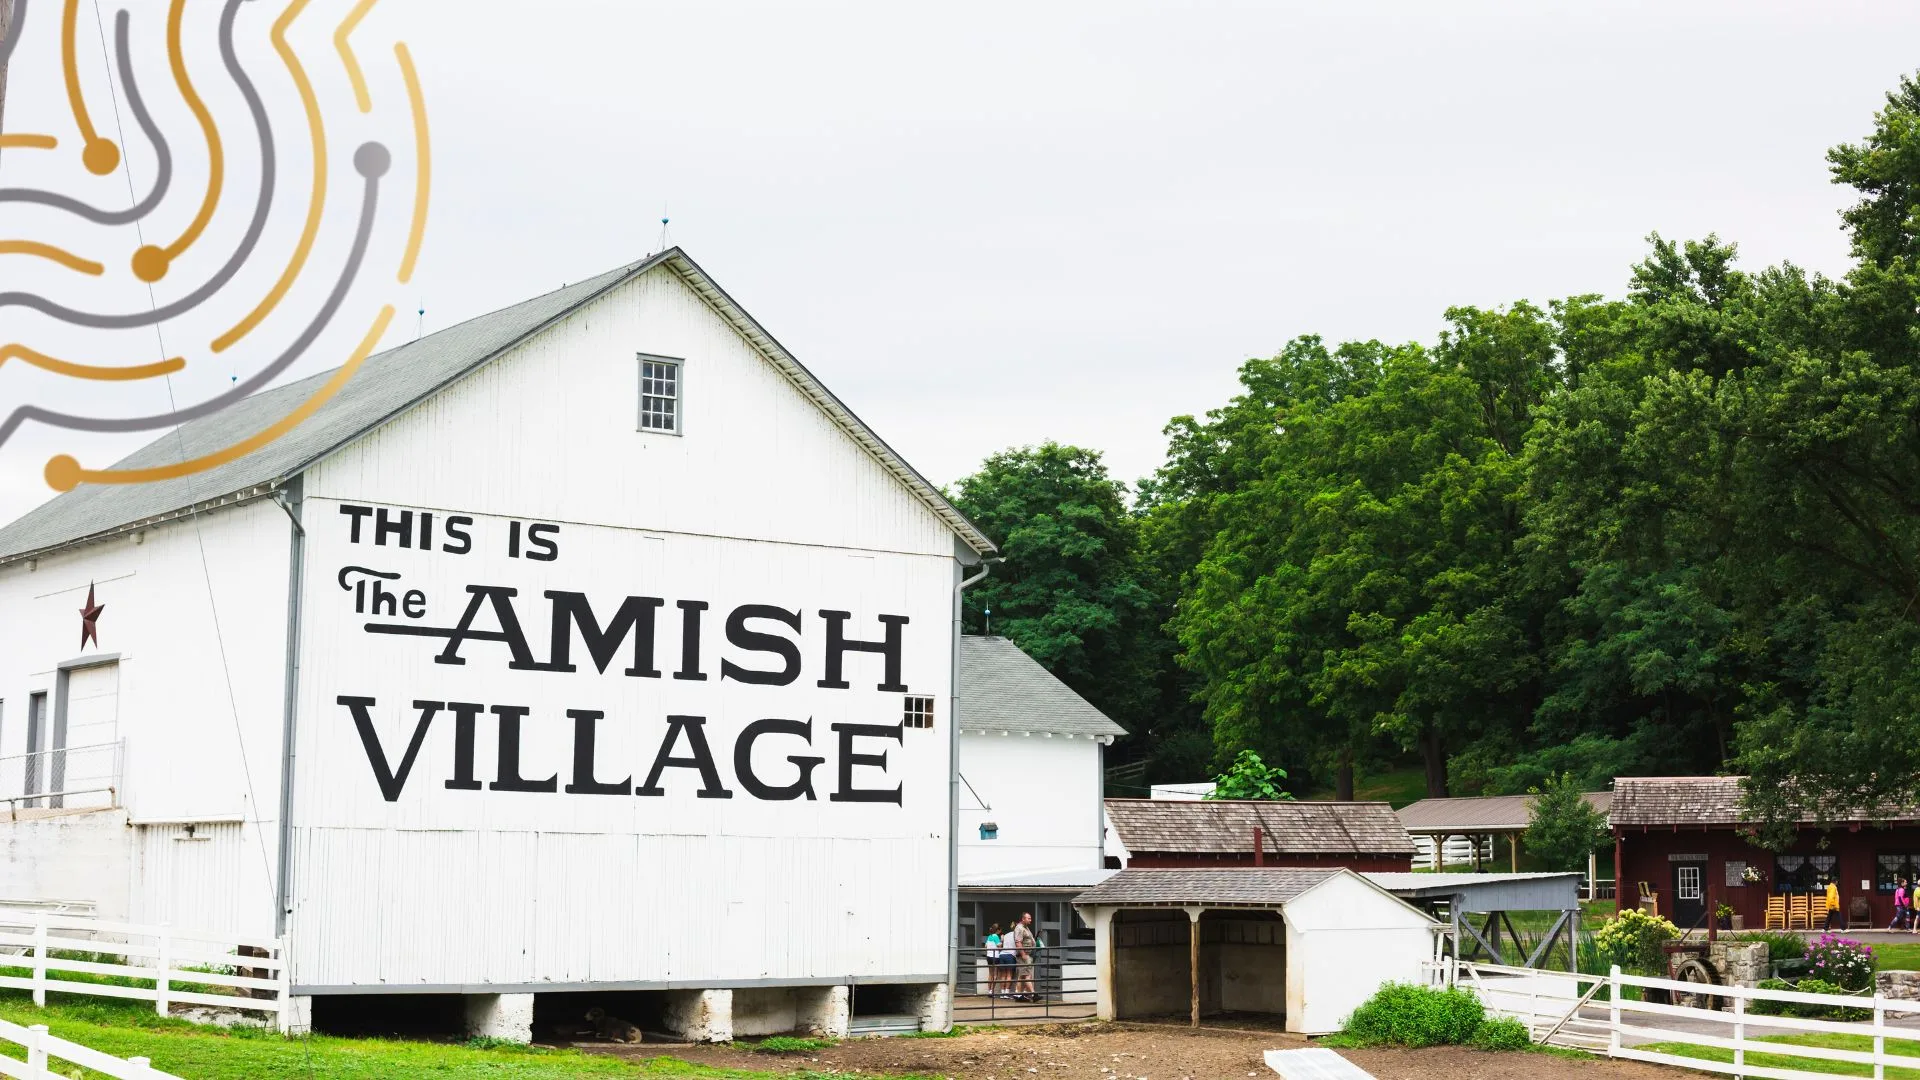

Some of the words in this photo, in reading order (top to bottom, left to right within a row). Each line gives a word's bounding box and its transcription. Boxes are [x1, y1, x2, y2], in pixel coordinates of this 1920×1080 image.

[339, 504, 474, 555] THIS
[508, 520, 560, 562] IS
[337, 565, 427, 619] The
[364, 584, 910, 693] AMISH
[336, 695, 904, 808] VILLAGE
